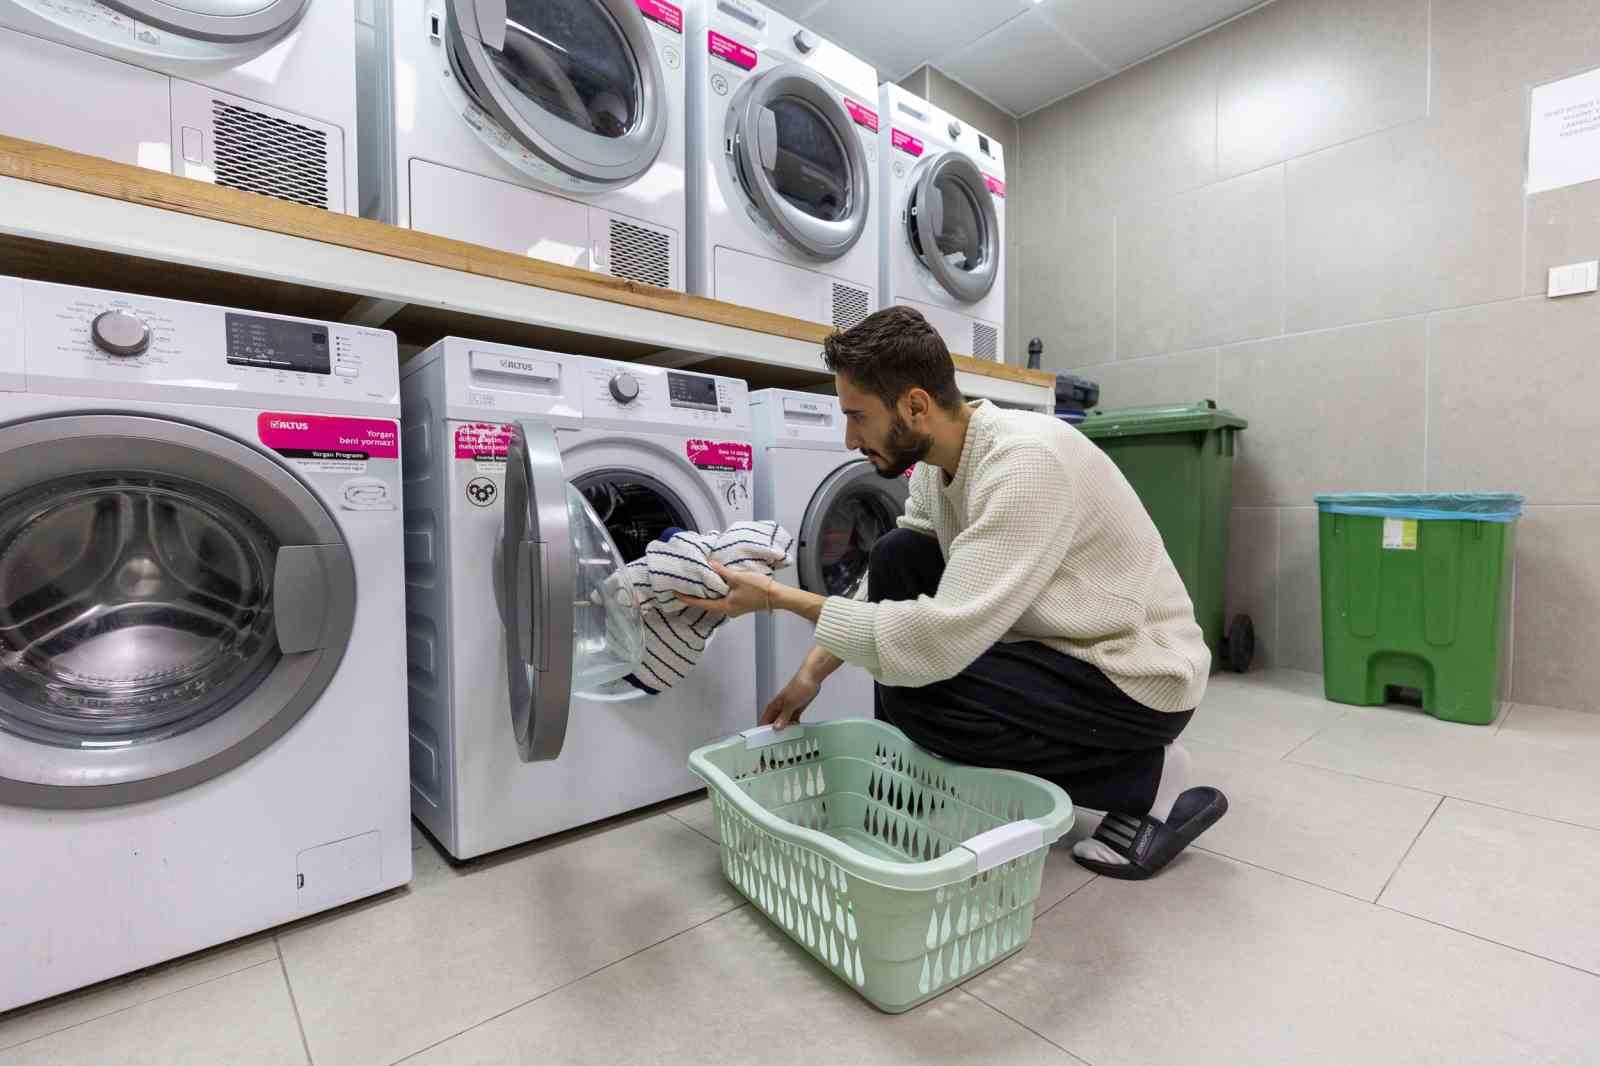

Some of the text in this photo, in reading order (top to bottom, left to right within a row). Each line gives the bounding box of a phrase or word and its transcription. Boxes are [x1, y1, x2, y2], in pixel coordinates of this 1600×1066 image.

[508, 360, 534, 371] ALTUS
[279, 421, 309, 431] ALTUS
[366, 430, 395, 440] Yorgan
